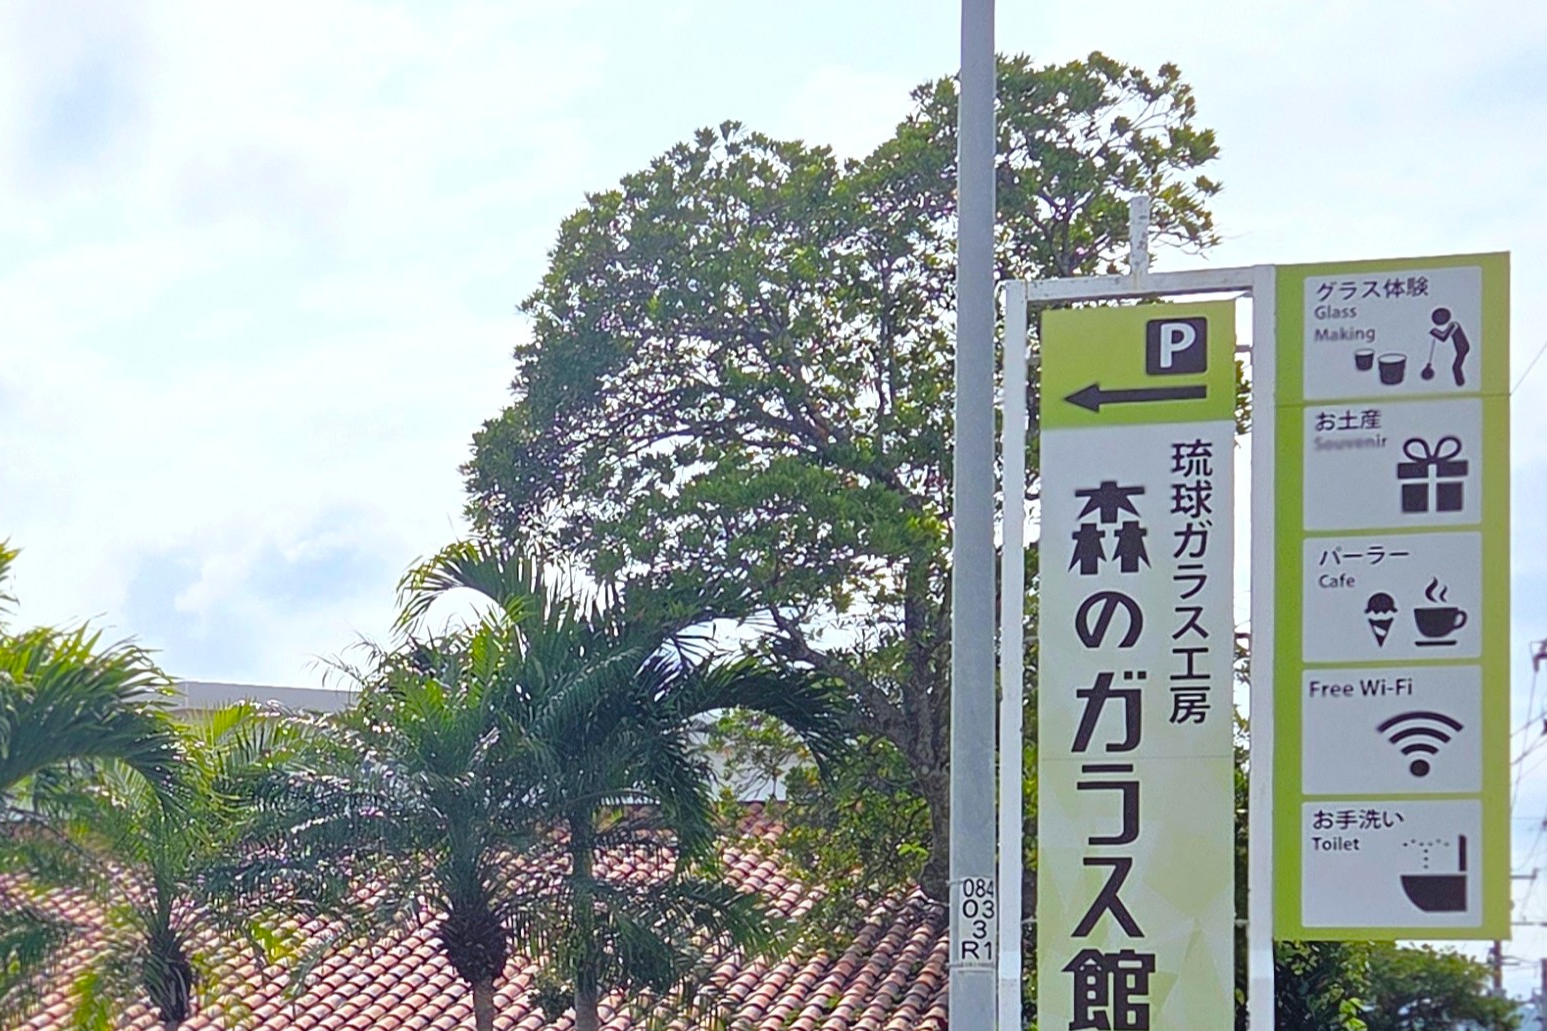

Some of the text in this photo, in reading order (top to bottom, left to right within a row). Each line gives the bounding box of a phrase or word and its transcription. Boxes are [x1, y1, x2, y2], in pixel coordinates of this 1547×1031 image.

[1316, 276, 1429, 301] グラス体験
[1313, 305, 1357, 321] Glass
[1160, 322, 1197, 367] P
[1313, 328, 1376, 343] Making
[1314, 409, 1383, 432] お土産
[1313, 434, 1388, 451] Souvenir
[1318, 546, 1410, 566] パーラー
[1169, 439, 1213, 724] 琉球ガラス工房
[1318, 573, 1356, 588] Cafe
[1309, 678, 1414, 698] Free Wi-Fi
[1060, 480, 1156, 1031] 森のガラス館
[1312, 809, 1405, 831] お手洗い
[1311, 836, 1361, 851] Toilet
[972, 920, 988, 939] 3
